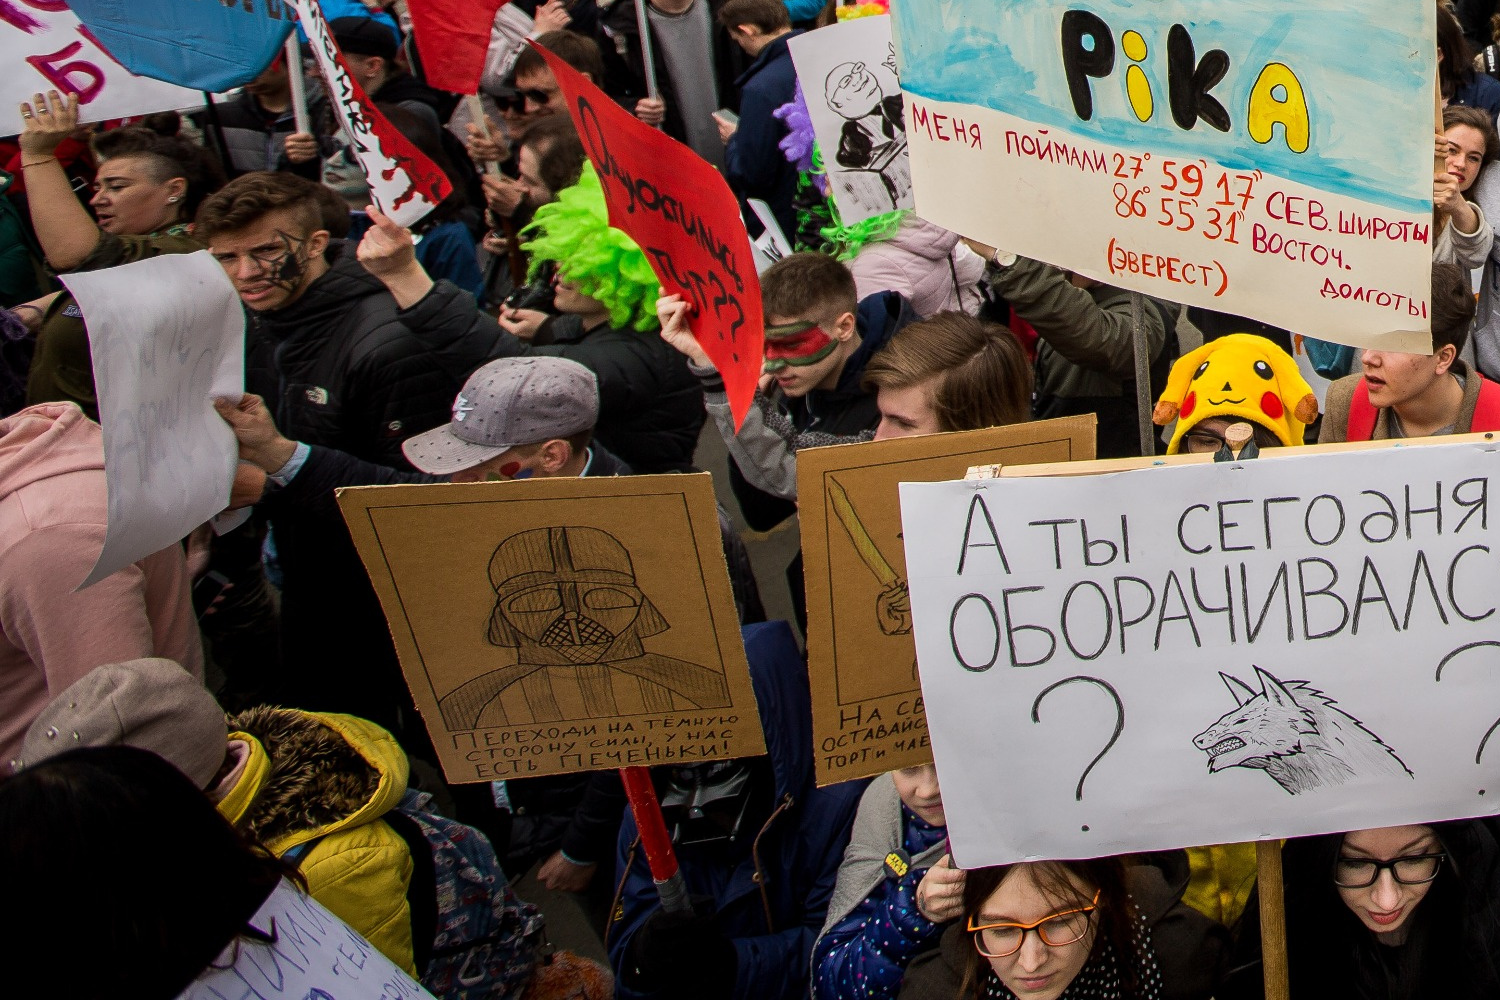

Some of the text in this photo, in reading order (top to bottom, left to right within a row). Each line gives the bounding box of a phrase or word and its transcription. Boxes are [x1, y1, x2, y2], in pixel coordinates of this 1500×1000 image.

[911, 101, 984, 150] МЕНЯ
[1005, 129, 1108, 175] ПОЙМАЛИ
[1266, 190, 1334, 234] СЕВ.
[1337, 212, 1429, 245] ШИРОТЫ
[1107, 237, 1229, 298] (ЭВЕРЕСТ)
[1251, 222, 1353, 272] ВОСТОЧ.
[1319, 277, 1428, 320] ДОЛГОТЫ
[956, 477, 1490, 575] А ТЫ СЕГОДНЯ
[451, 712, 740, 753] ПЕРЕХОДИ НА ТЁМНУЮ
[839, 705, 882, 730] НА
[464, 728, 734, 764] СТОРОНУ СИЛЫ, У НАС
[474, 740, 732, 780] ЕСТЬ ПЕЧЕНЬКИ!
[824, 747, 872, 770] ТОРТ
[1030, 675, 1126, 833] ?
